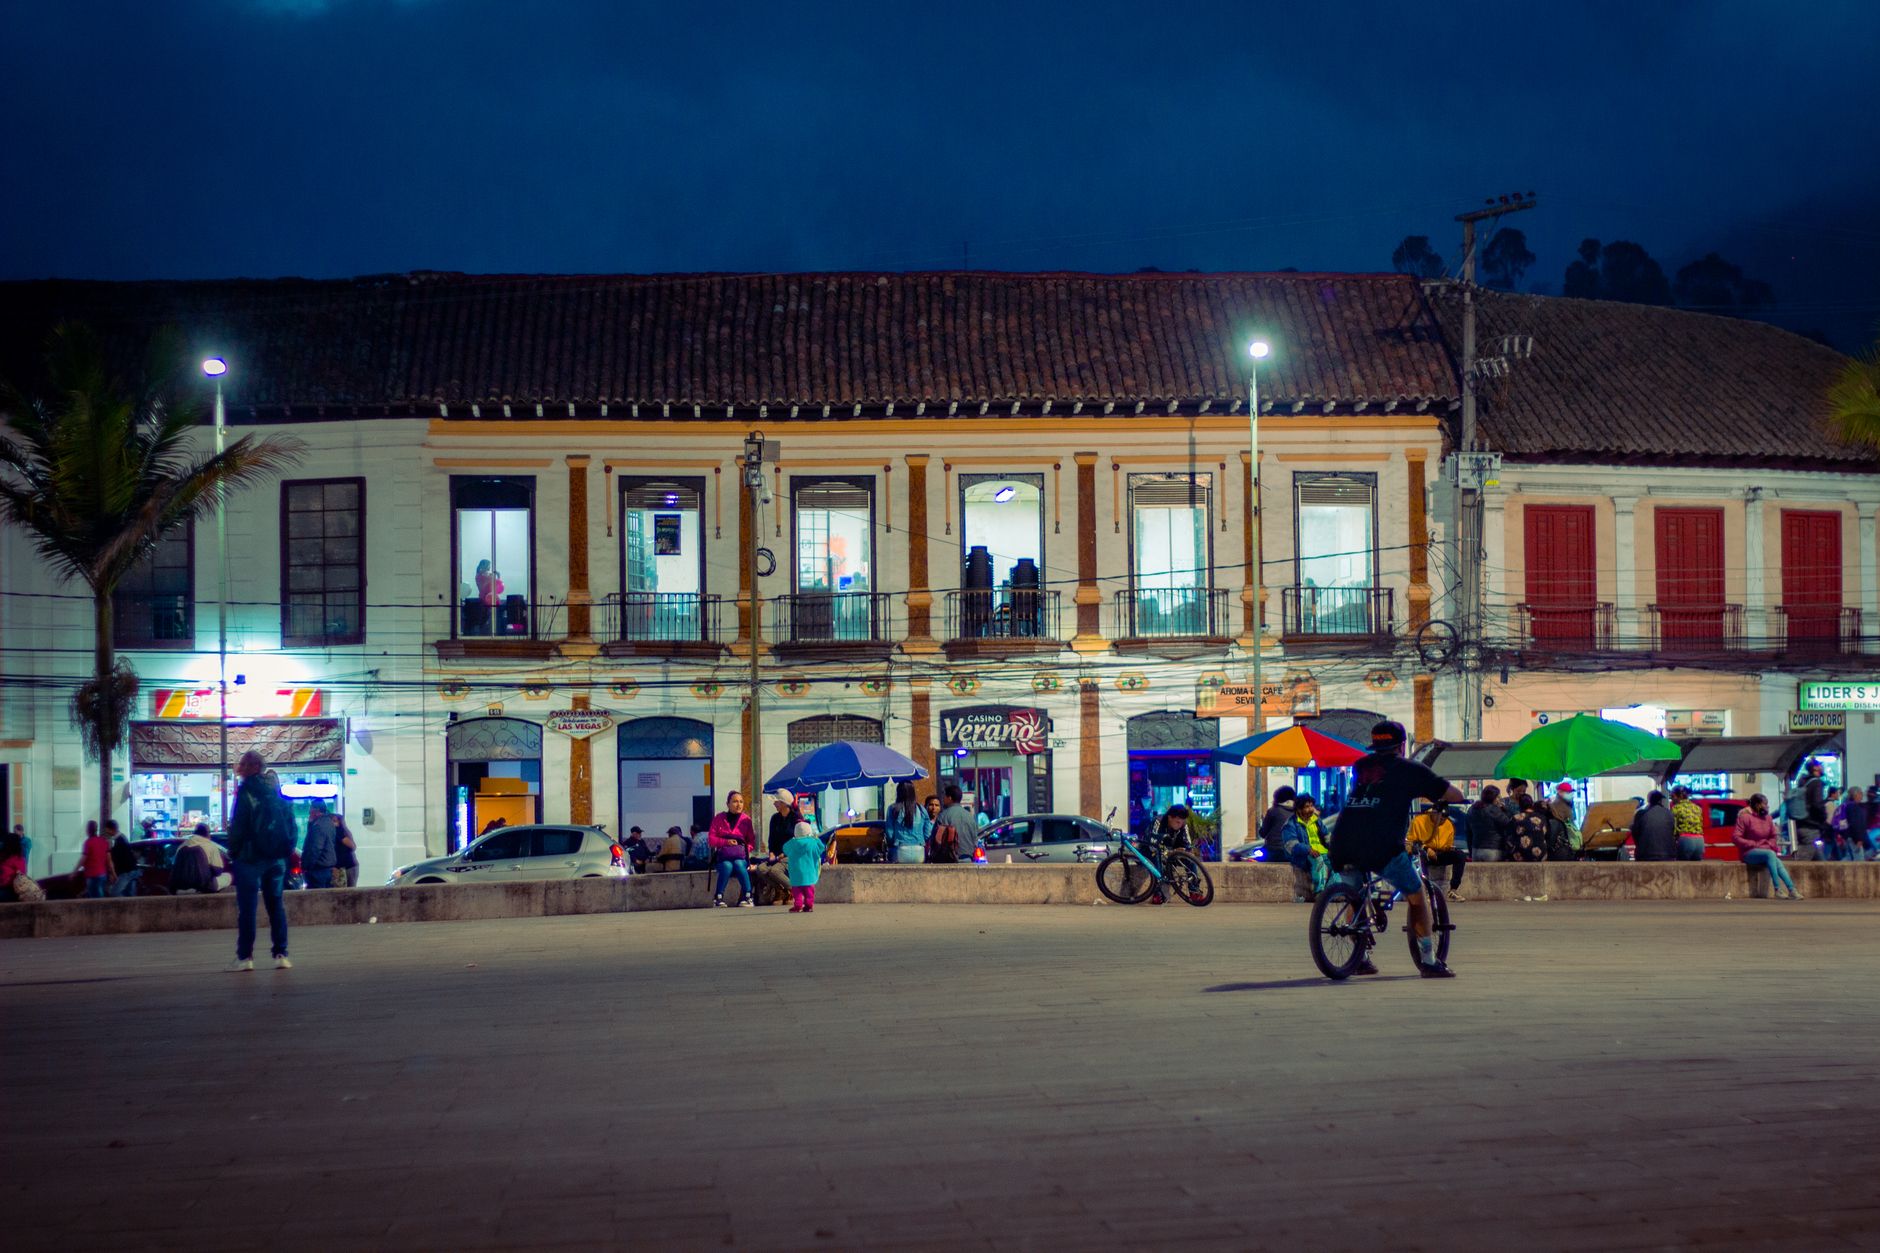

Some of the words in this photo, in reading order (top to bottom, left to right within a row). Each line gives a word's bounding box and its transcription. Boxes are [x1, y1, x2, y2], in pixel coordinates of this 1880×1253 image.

[1220, 687, 1249, 695] AROMA
[1807, 686, 1865, 699] LIDER'S
[1235, 696, 1267, 704] SEVIA
[967, 714, 1003, 723] CASINO
[1793, 713, 1825, 726] COMPRO
[1826, 713, 1843, 726] ORO
[943, 717, 1035, 742] Verano
